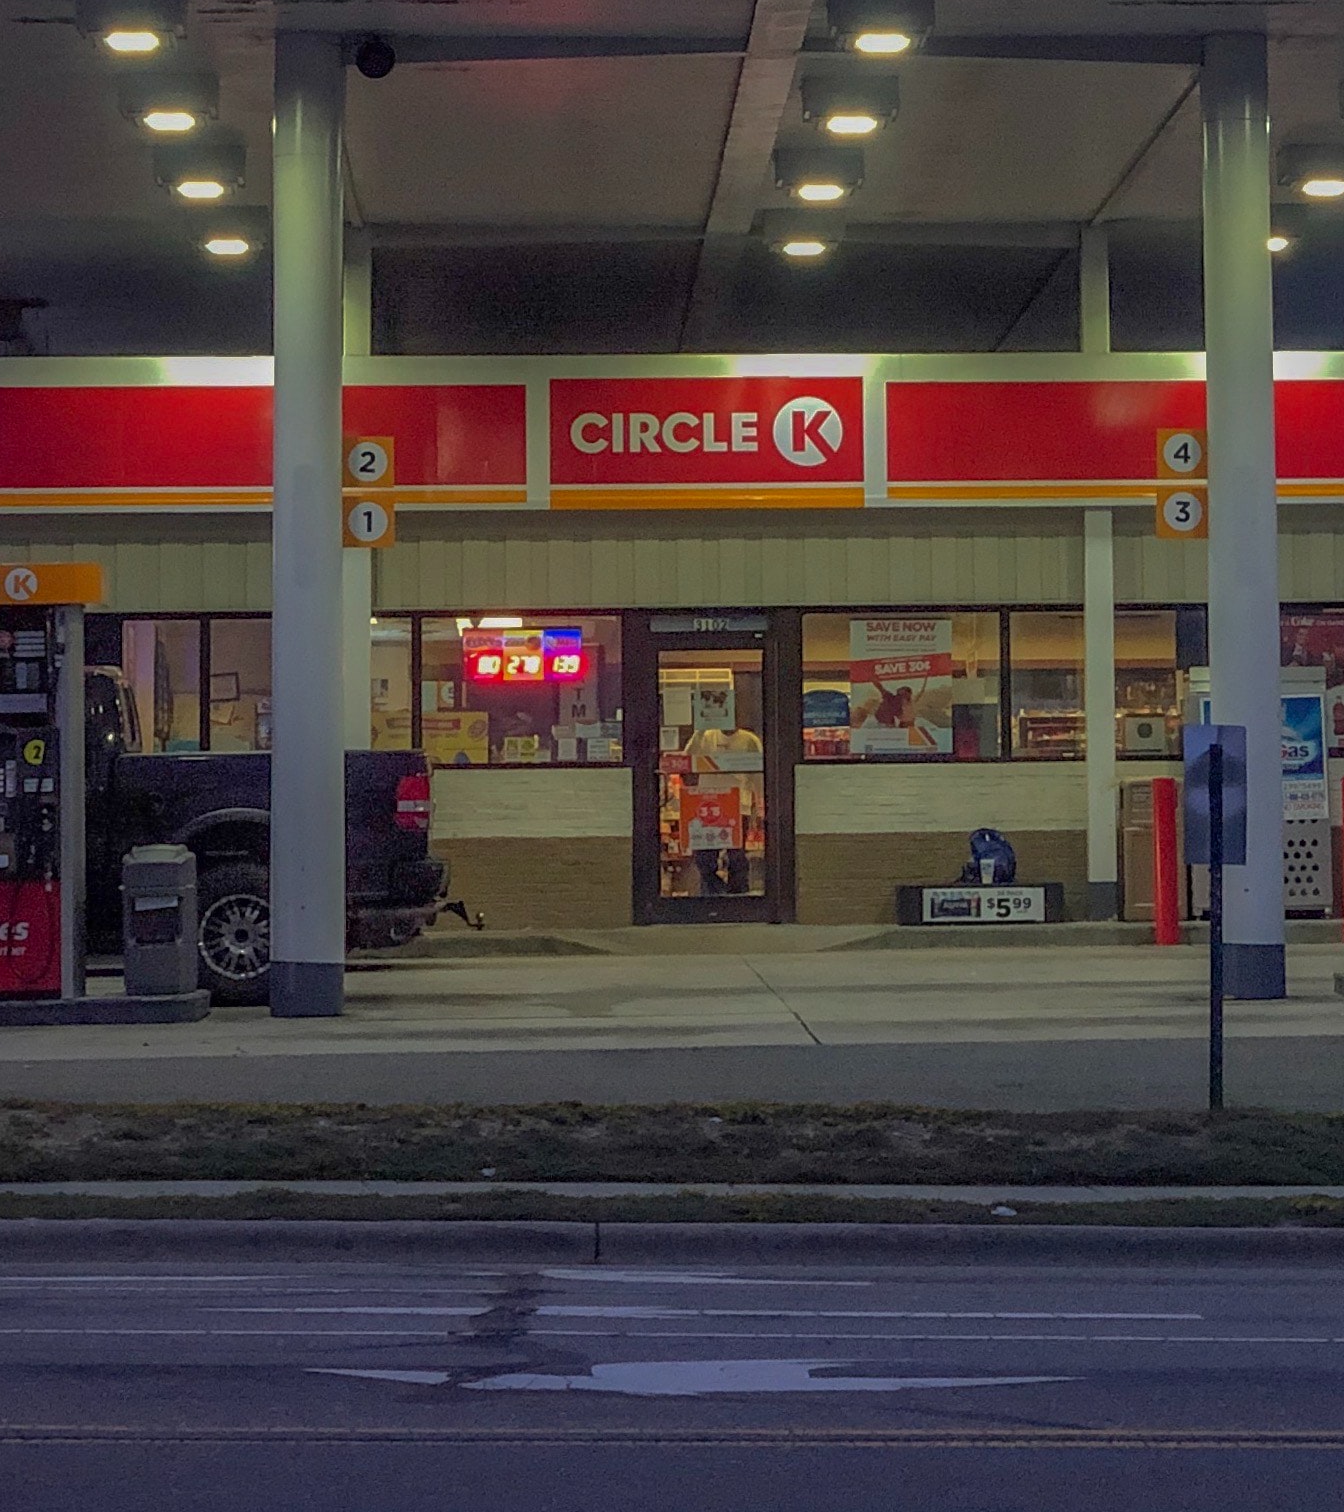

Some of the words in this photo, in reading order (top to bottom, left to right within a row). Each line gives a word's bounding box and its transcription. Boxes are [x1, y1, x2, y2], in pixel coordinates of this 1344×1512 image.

[570, 411, 758, 453] CIRCLE
[791, 409, 836, 465] K
[359, 451, 375, 473] 2
[1173, 442, 1190, 464] 4
[363, 511, 372, 532] 1
[1175, 501, 1190, 522] 3
[866, 621, 902, 632] SAVE
[904, 621, 937, 632] NOW
[874, 662, 906, 675] SAVE
[33, 746, 42, 759] 2
